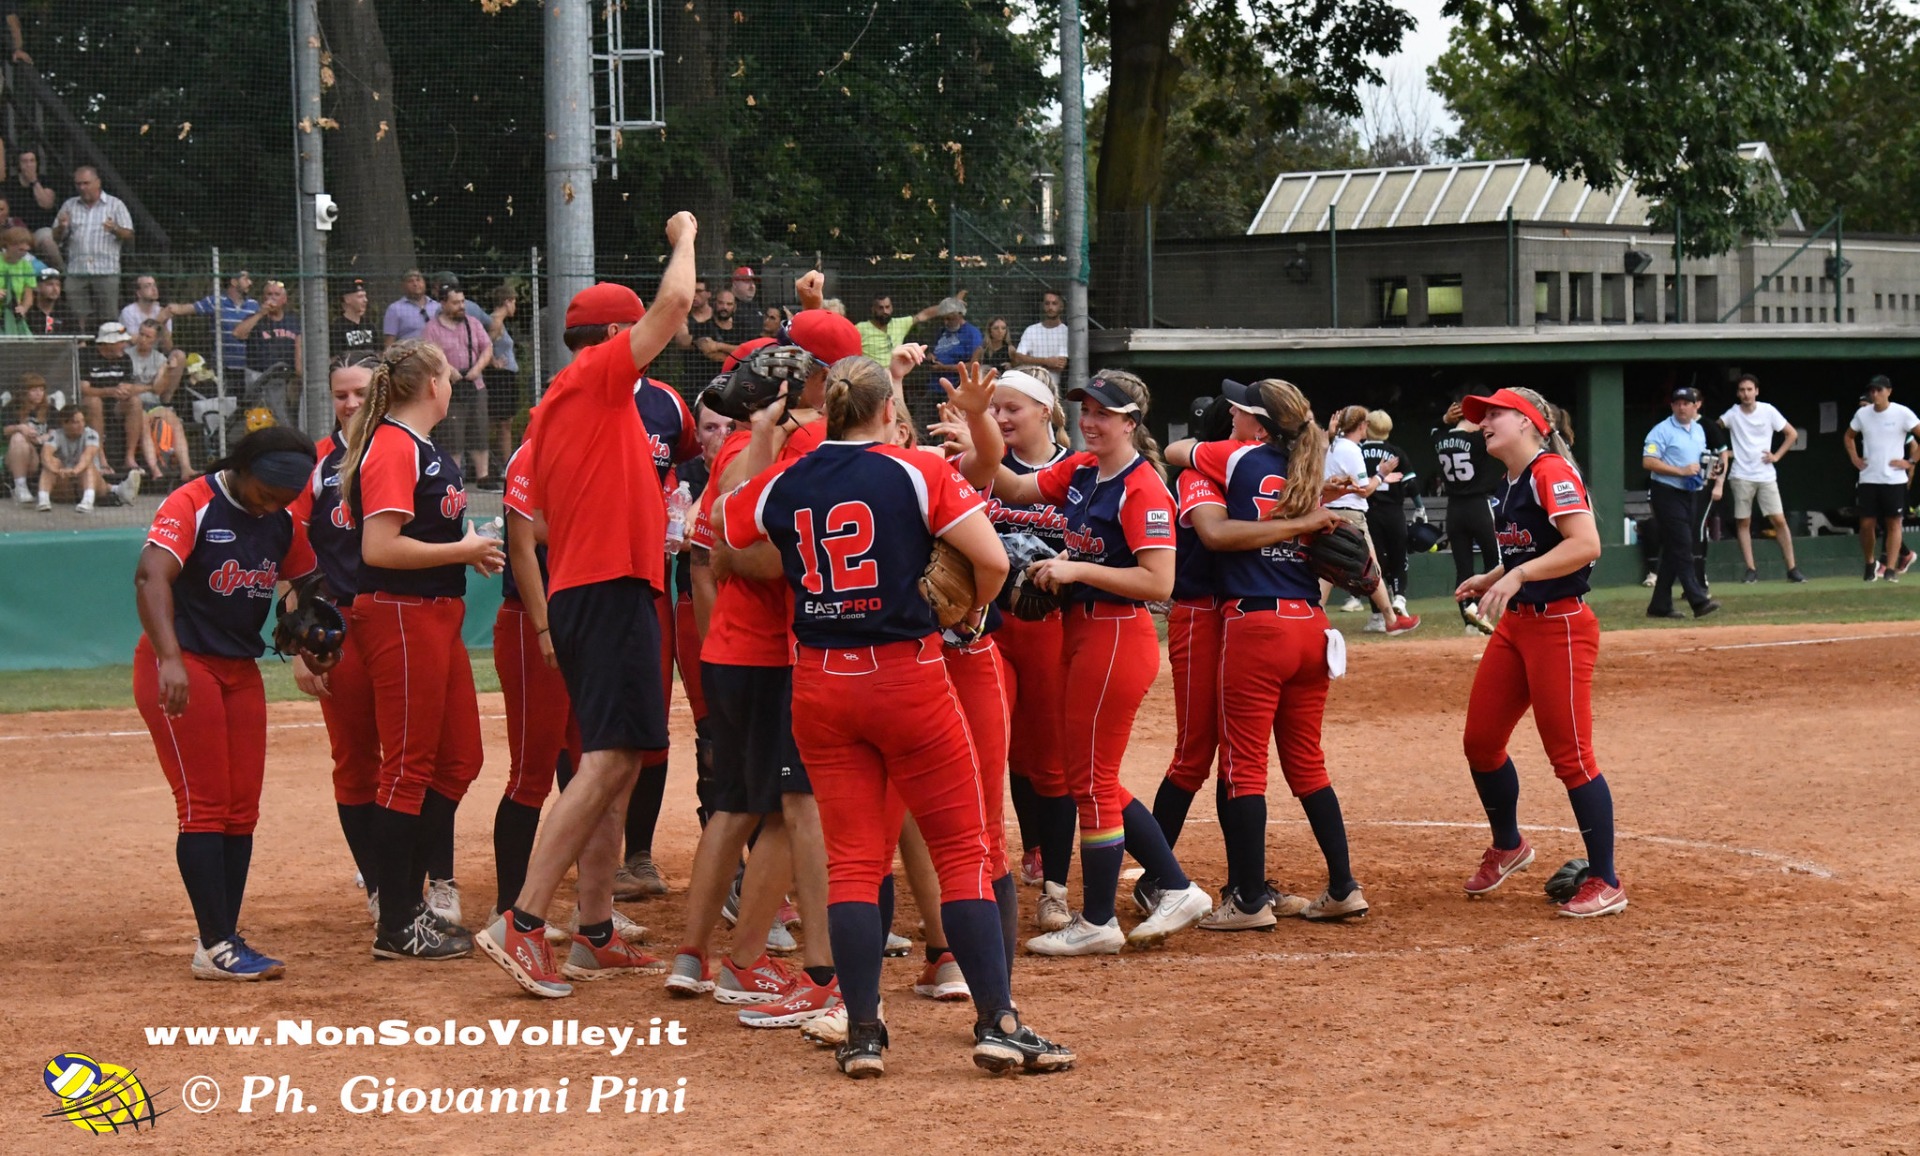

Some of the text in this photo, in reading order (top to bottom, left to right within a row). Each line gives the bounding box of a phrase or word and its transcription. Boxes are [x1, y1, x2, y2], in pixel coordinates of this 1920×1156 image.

[1438, 452, 1475, 482] 25
[514, 475, 530, 488] afé
[510, 487, 528, 502] Hut
[959, 488, 970, 499] de
[1196, 489, 1214, 498] Hu
[1151, 512, 1167, 520] DMC
[794, 500, 879, 594] 12
[804, 597, 883, 614] EASTPRO
